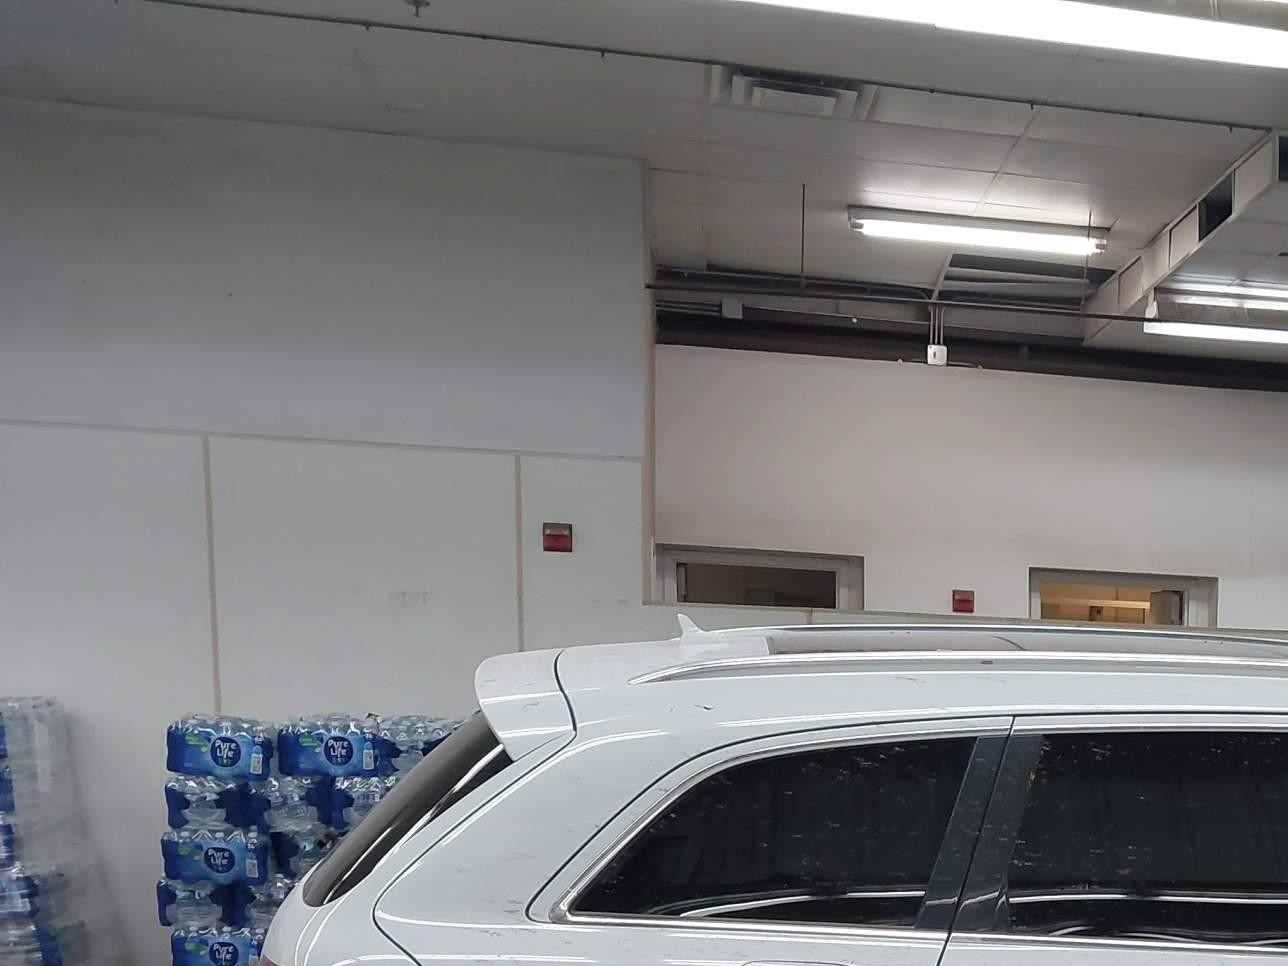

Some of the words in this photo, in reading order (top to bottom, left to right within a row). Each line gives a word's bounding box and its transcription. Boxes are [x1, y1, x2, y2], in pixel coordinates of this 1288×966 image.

[215, 739, 237, 753] Pure
[327, 739, 349, 752] Pure
[216, 748, 234, 759] Life
[330, 747, 347, 758] Life
[208, 848, 230, 859] Pure
[210, 855, 228, 867] Life
[213, 943, 235, 954] Pure
[215, 950, 232, 963] Life
